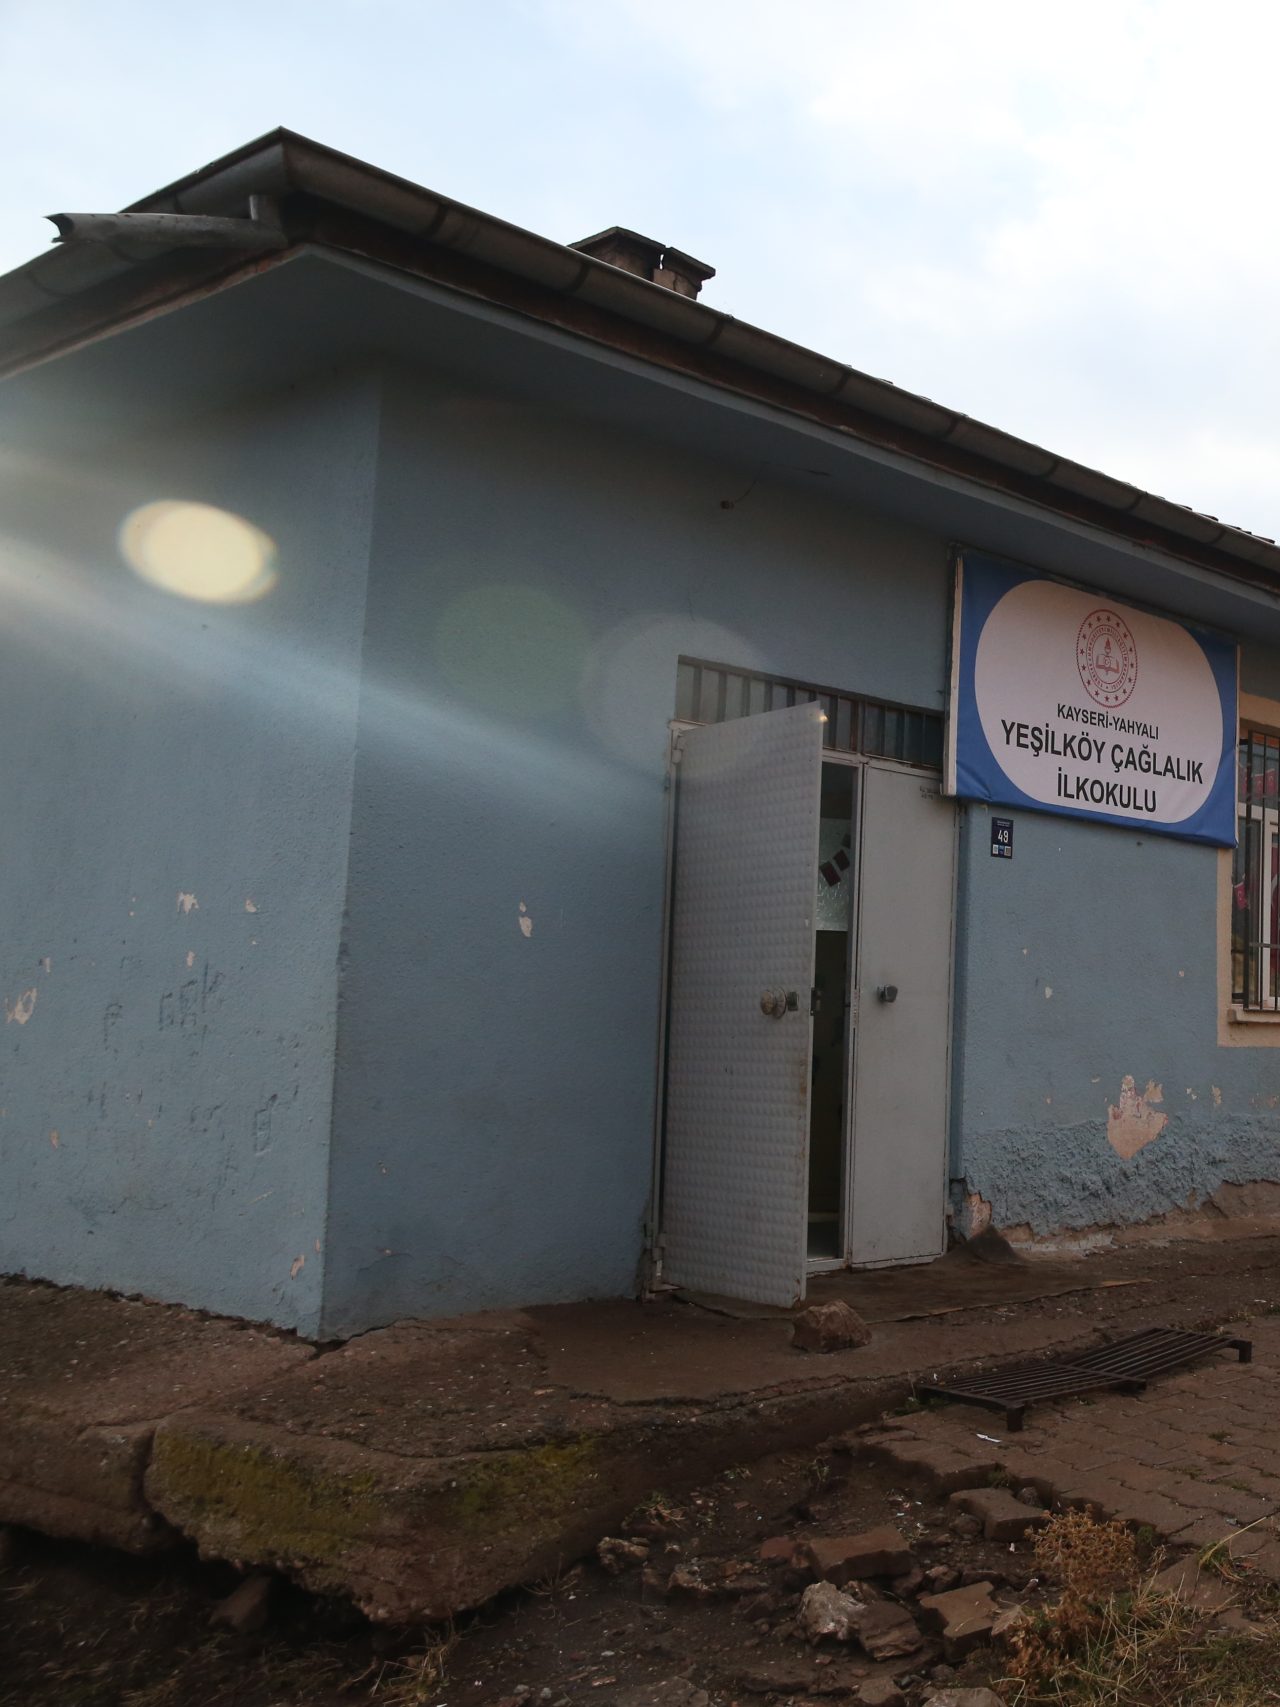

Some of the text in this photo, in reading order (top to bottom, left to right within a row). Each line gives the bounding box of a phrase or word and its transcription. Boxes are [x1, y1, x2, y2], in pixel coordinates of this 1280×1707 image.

[1057, 703, 1160, 740] KAYSERİ-YAHYALI
[1000, 719, 1204, 785] YEŞİLKÖY ÇAĞLALIK
[1057, 767, 1157, 813] İLKOKULU
[997, 829, 1009, 844] 49
